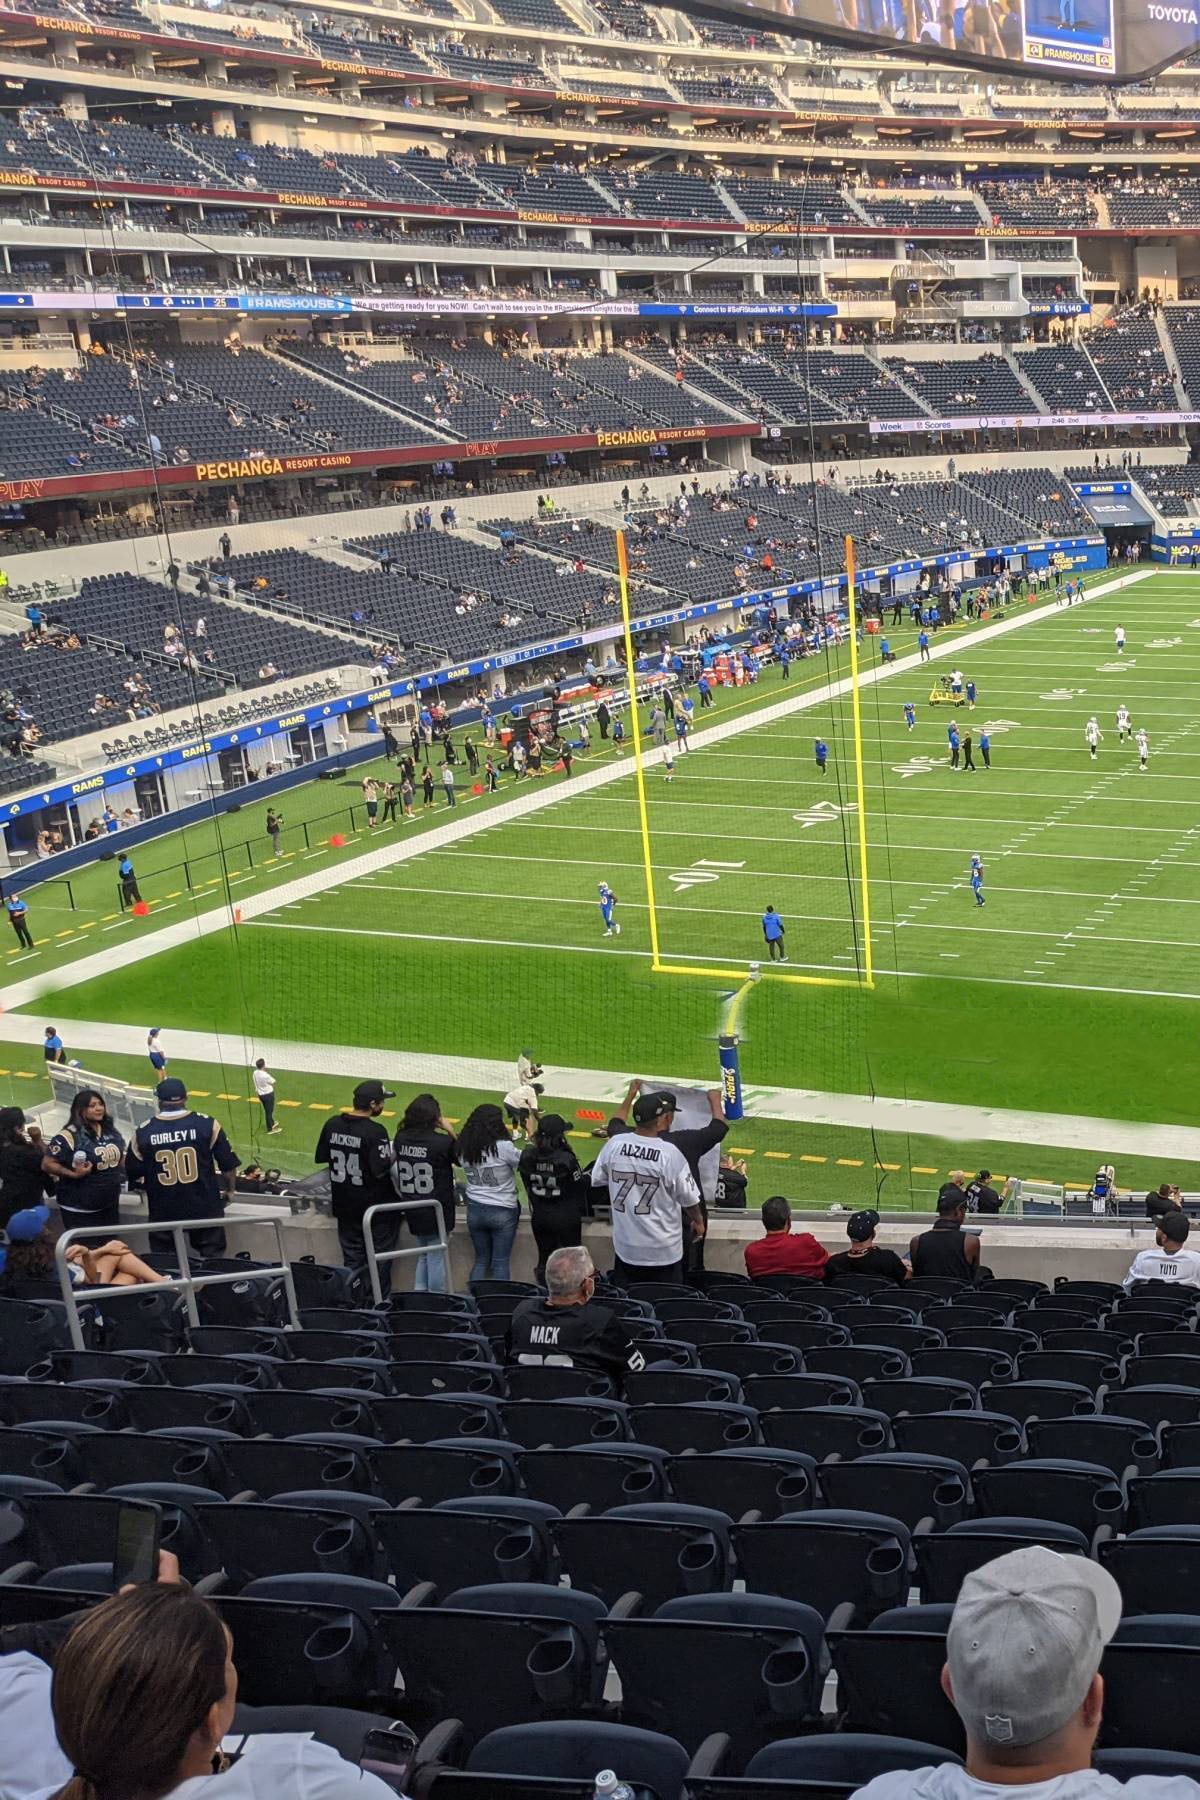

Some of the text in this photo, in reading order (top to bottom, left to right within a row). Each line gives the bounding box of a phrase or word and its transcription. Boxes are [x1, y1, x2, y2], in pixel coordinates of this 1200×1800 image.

[1147, 4, 1198, 25] TOYOTA
[36, 16, 94, 35] PECHANGA
[95, 28, 118, 36] RESORT
[1044, 47, 1095, 64] #RAMSHOUSE
[321, 60, 368, 76] PECHANGA
[555, 91, 601, 104] PECHANGA
[794, 112, 838, 122] PECHANGA
[1023, 119, 1067, 129] PECHANGA
[37, 178, 88, 188] RESORT CASINO
[278, 194, 328, 206] PECHANGA
[518, 211, 558, 222] PECHANGA
[744, 223, 790, 233] PECHANGA
[975, 228, 1018, 236] PECHANGA
[248, 297, 335, 309] #RAMSHOUSE
[355, 301, 367, 309] We
[381, 302, 404, 312] getting
[406, 301, 424, 312] ready
[425, 301, 436, 309] for
[437, 303, 449, 312] you
[450, 301, 469, 310] NOW!
[472, 301, 490, 310] Can't
[1054, 304, 1082, 313] $11,140
[880, 422, 902, 431] Week
[924, 421, 951, 429] Scores
[598, 429, 706, 446] PECHANGA RESORT CASINO
[466, 441, 499, 456] PLAY
[197, 455, 352, 481] PECHANGA RESORT CASINO
[1090, 485, 1114, 493] RAMS
[447, 667, 469, 679] RAMS
[367, 689, 392, 703] RAMS
[279, 713, 306, 729] RAMS
[182, 742, 211, 759] RAMS
[72, 776, 104, 794] RAMS
[150, 1128, 197, 1147] GURLEY II
[330, 1132, 362, 1149] JACKSON
[95, 1143, 121, 1171] 30
[378, 1144, 391, 1159] 34
[399, 1144, 428, 1159] JACOBS
[620, 1143, 661, 1162] ALZADO
[155, 1146, 199, 1187] 30
[330, 1149, 364, 1186] 34
[399, 1161, 435, 1194] 28
[529, 1173, 561, 1197] 24
[611, 1169, 660, 1215] 77
[1159, 1263, 1178, 1276] YUYO
[530, 1325, 561, 1346] MACK
